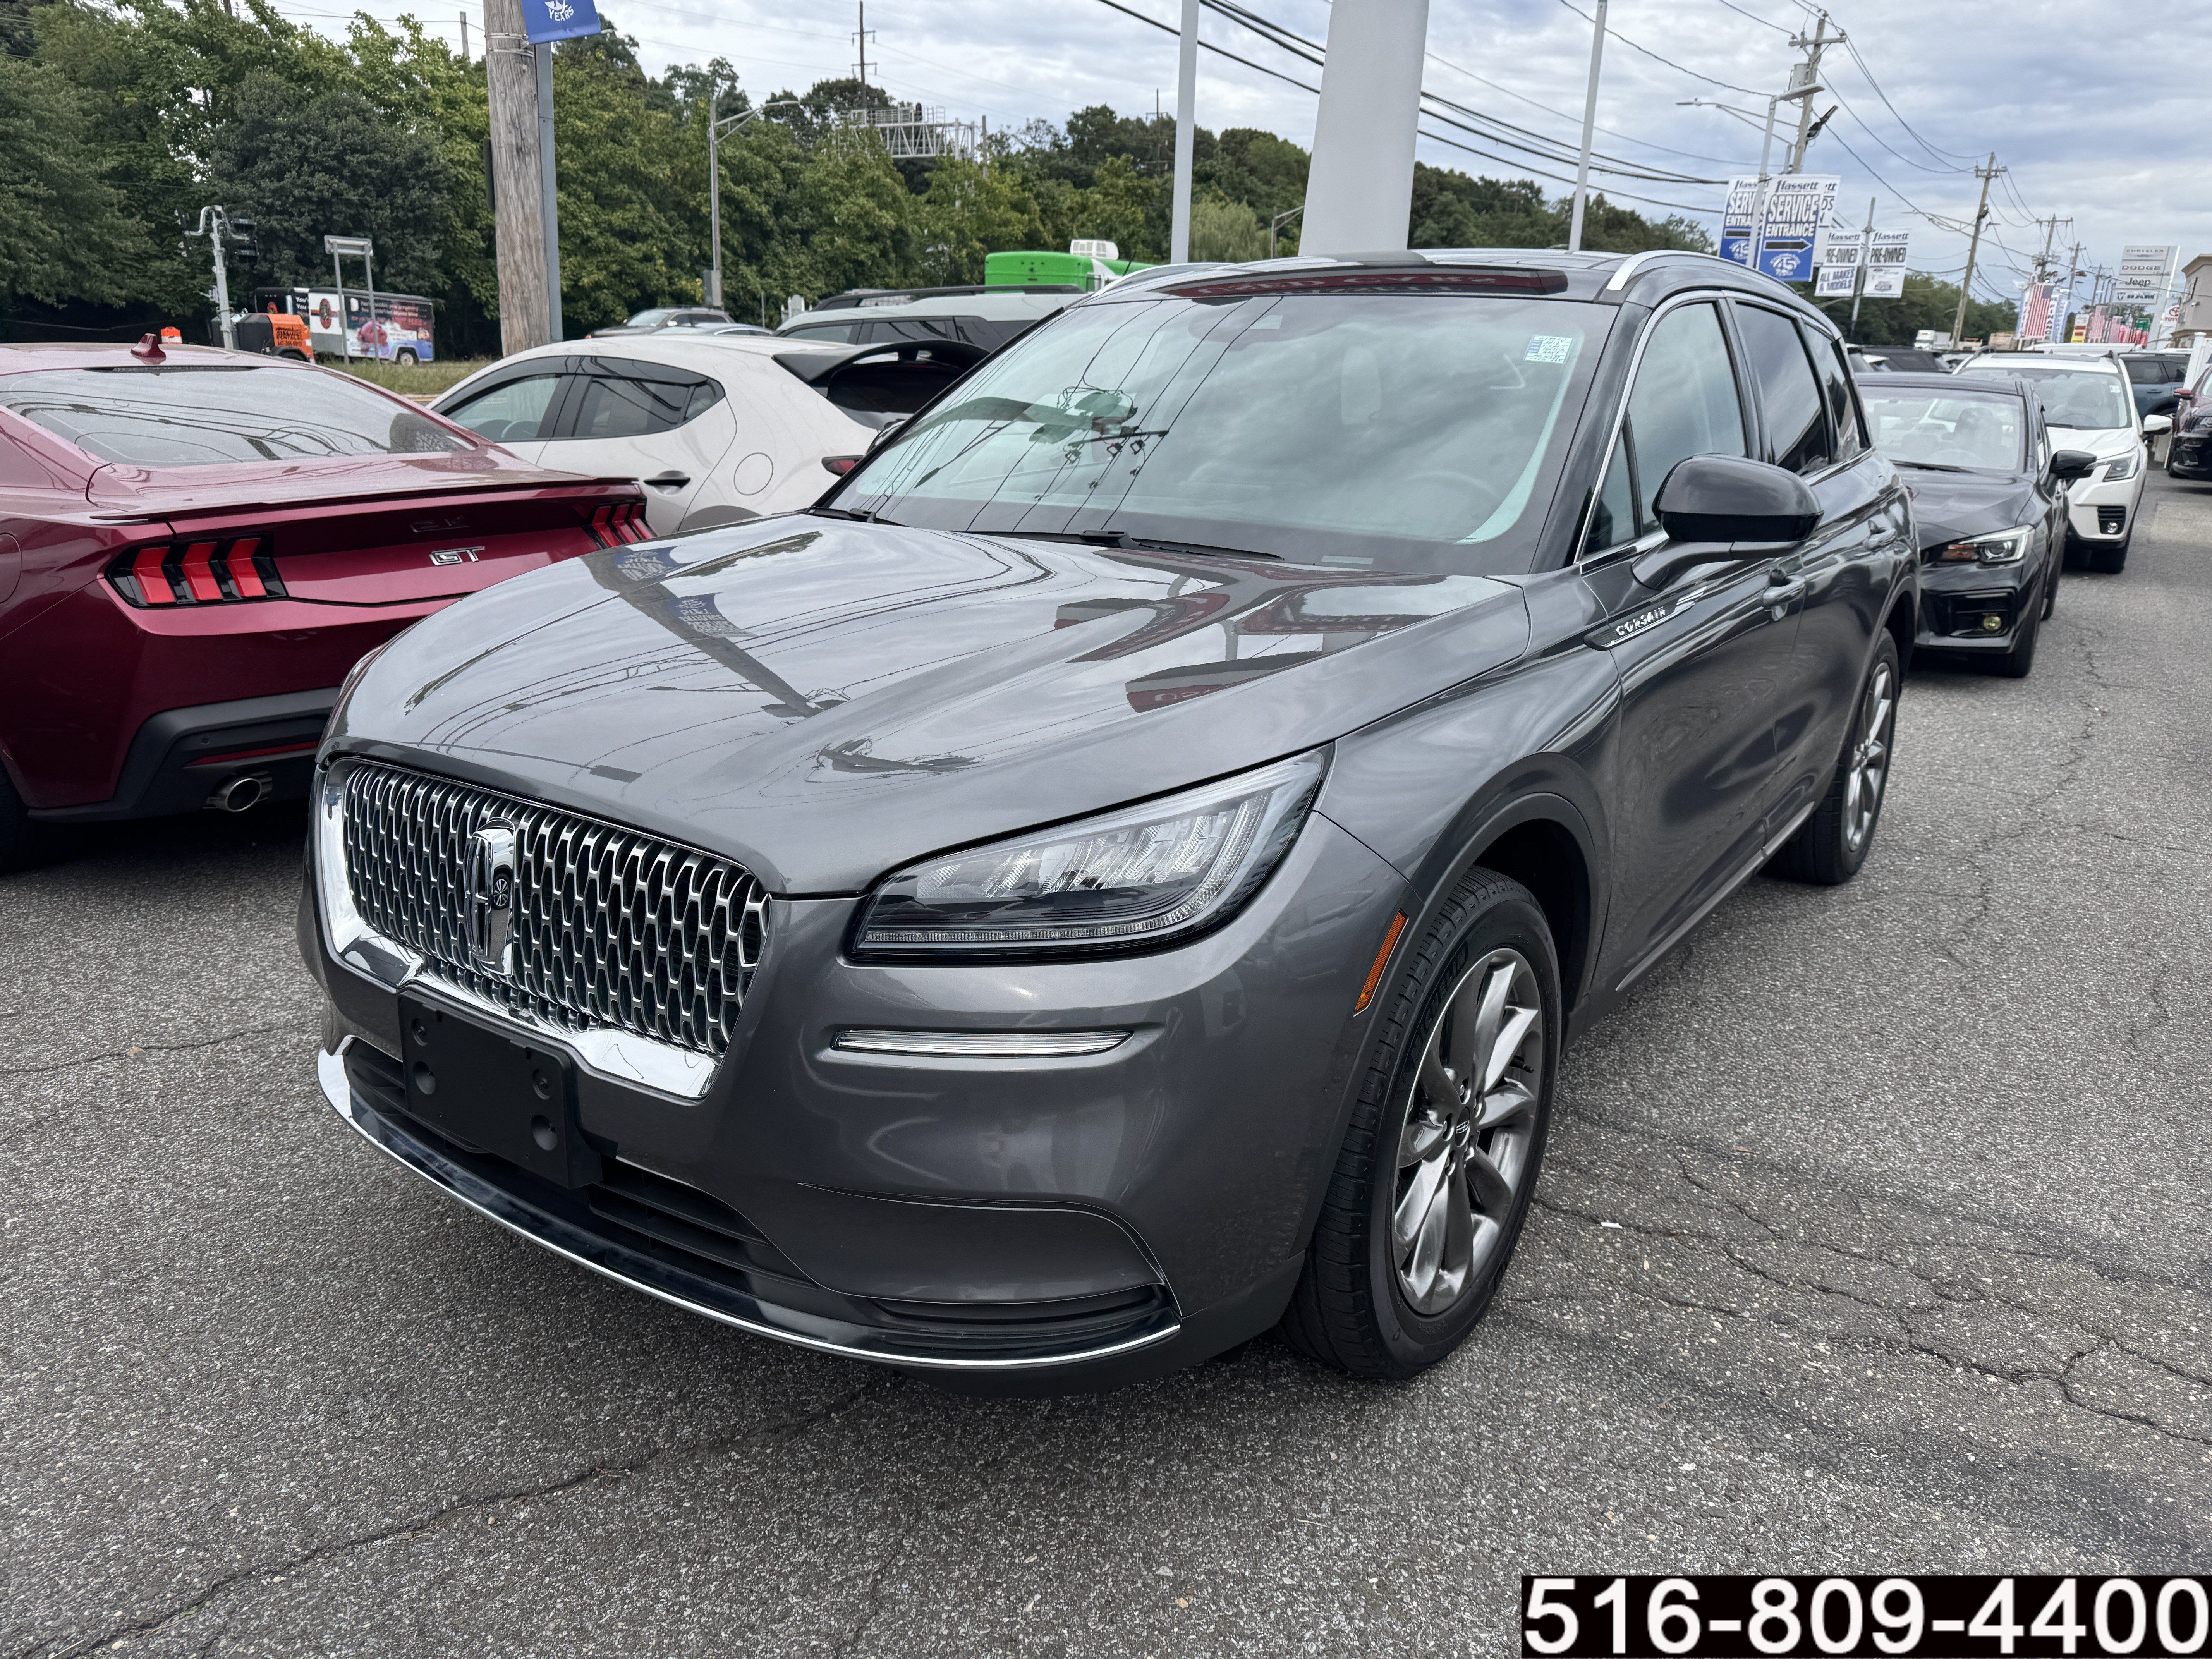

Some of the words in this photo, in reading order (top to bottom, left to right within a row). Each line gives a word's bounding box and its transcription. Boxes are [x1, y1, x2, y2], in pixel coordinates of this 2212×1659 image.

[548, 5, 574, 21] YEARS
[1775, 180, 1819, 192] Hassett
[1768, 194, 1820, 222] SERVICE
[1765, 222, 1815, 237] ENTRANCE
[1872, 232, 1909, 242] Hassett
[1870, 247, 1907, 263] PRE-OWNED
[2127, 277, 2151, 287] Jeep
[429, 546, 486, 566] GT
[1616, 606, 1665, 636] CORSAIR
